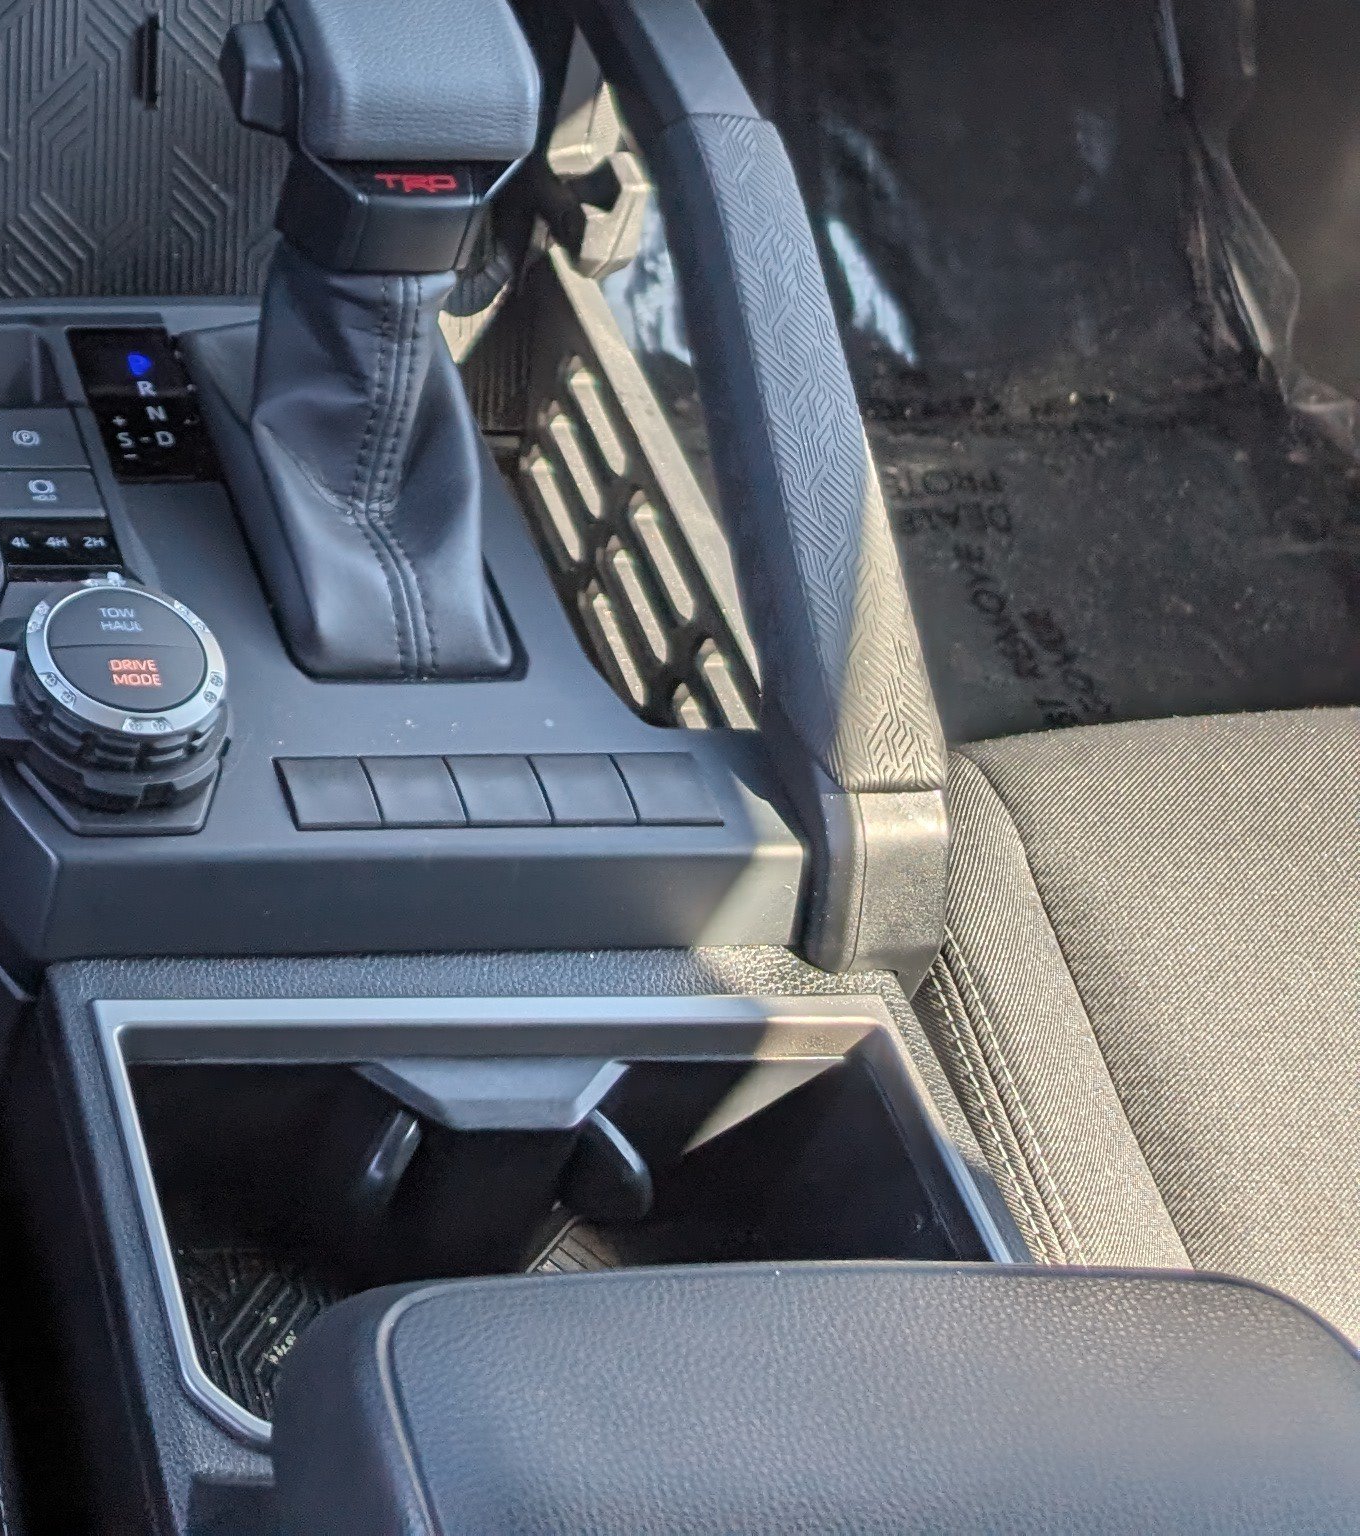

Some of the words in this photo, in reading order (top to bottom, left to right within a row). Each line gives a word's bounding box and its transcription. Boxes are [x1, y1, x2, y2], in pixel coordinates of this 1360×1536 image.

[375, 173, 458, 192] TRD
[136, 381, 156, 397] R
[146, 406, 168, 422] N
[116, 431, 133, 448] S
[155, 430, 176, 447] D
[11, 537, 29, 548] 4L
[45, 537, 68, 548] 4H
[83, 537, 106, 548] 2H
[99, 607, 135, 618] TOW
[100, 620, 143, 632] HAUL
[109, 659, 158, 671] DRIVE
[112, 673, 162, 686] MODE
